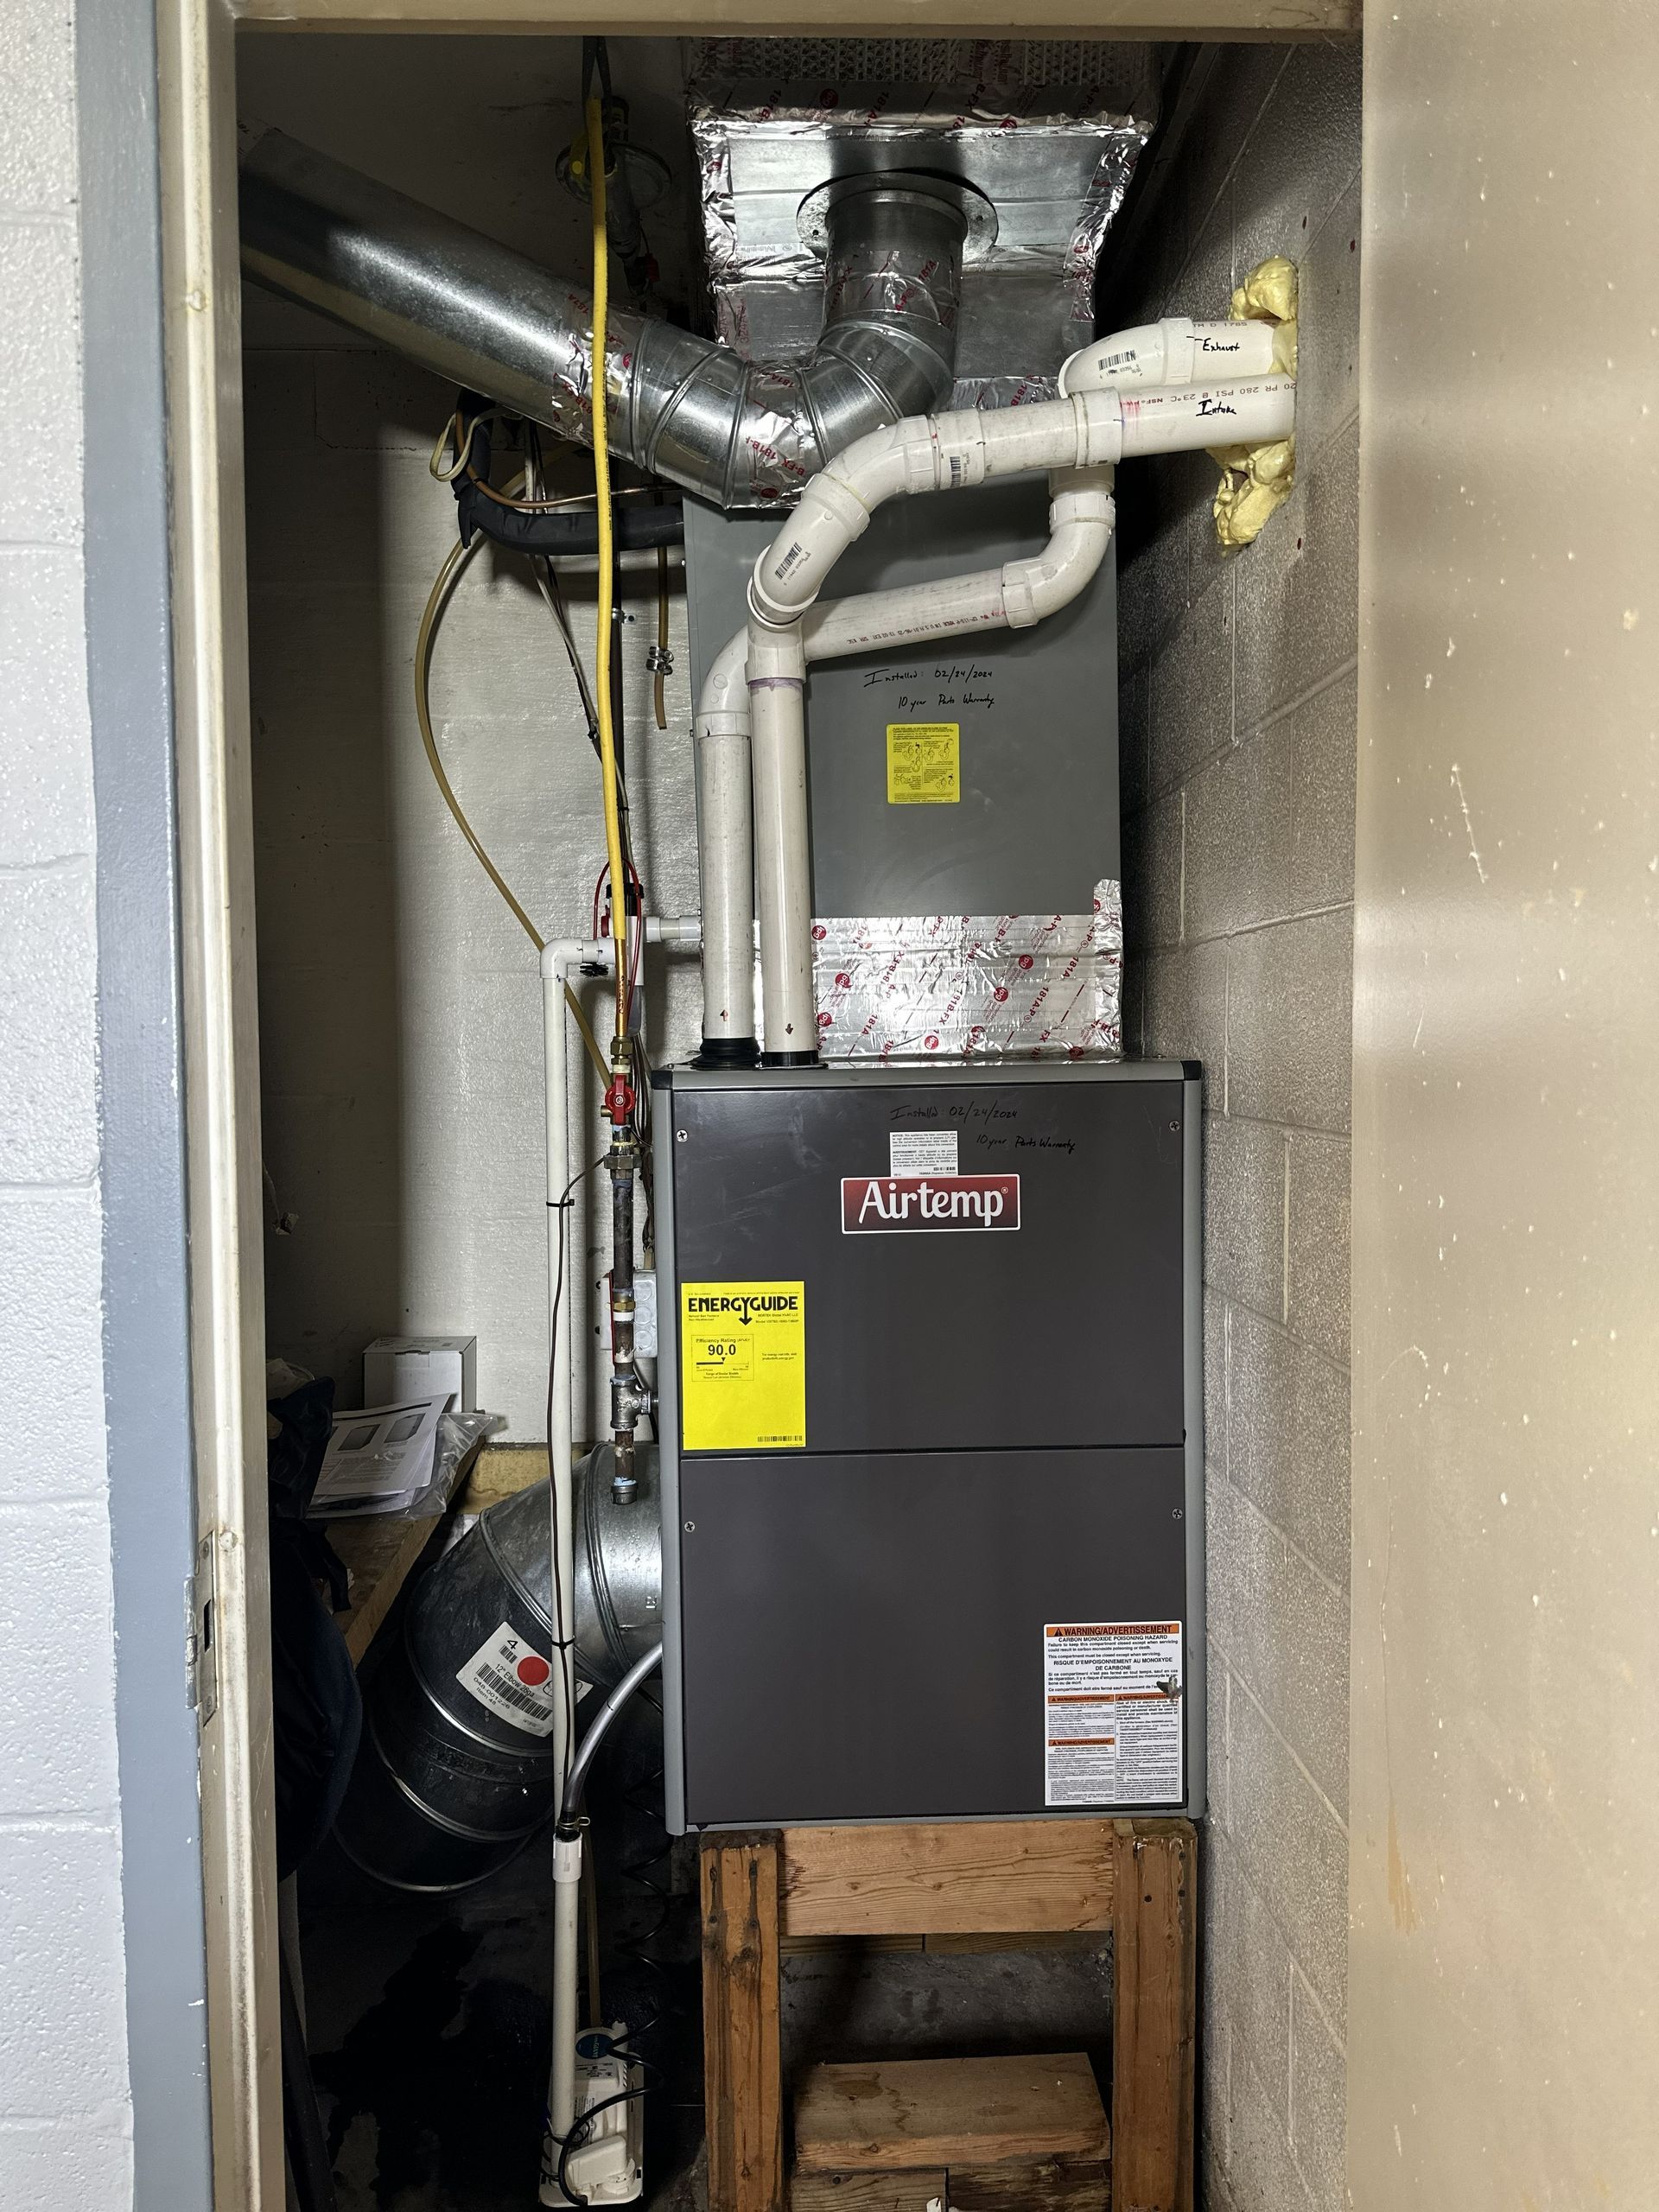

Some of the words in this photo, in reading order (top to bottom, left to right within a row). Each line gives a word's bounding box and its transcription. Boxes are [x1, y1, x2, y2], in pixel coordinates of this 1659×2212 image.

[1202, 338, 1240, 351] Exhaust
[1240, 386, 1259, 395] 280
[1196, 399, 1236, 416] Intake
[934, 664, 993, 683] 02/24/2024
[899, 696, 907, 709] 10
[911, 701, 927, 712] year
[939, 988, 962, 1025] 181B-FX
[950, 1101, 1018, 1124] 02/24/2024
[976, 1135, 987, 1144] 10
[688, 1296, 798, 1312] ENERGYGUIDE
[709, 1344, 736, 1356] 90.0
[1065, 1625, 1172, 1636] WARNING/ADVERTISSEMENT
[507, 1639, 518, 1649] 4
[495, 1663, 506, 1674] 12"
[504, 1672, 521, 1688] Elbow
[520, 1685, 535, 1697] 26ga
